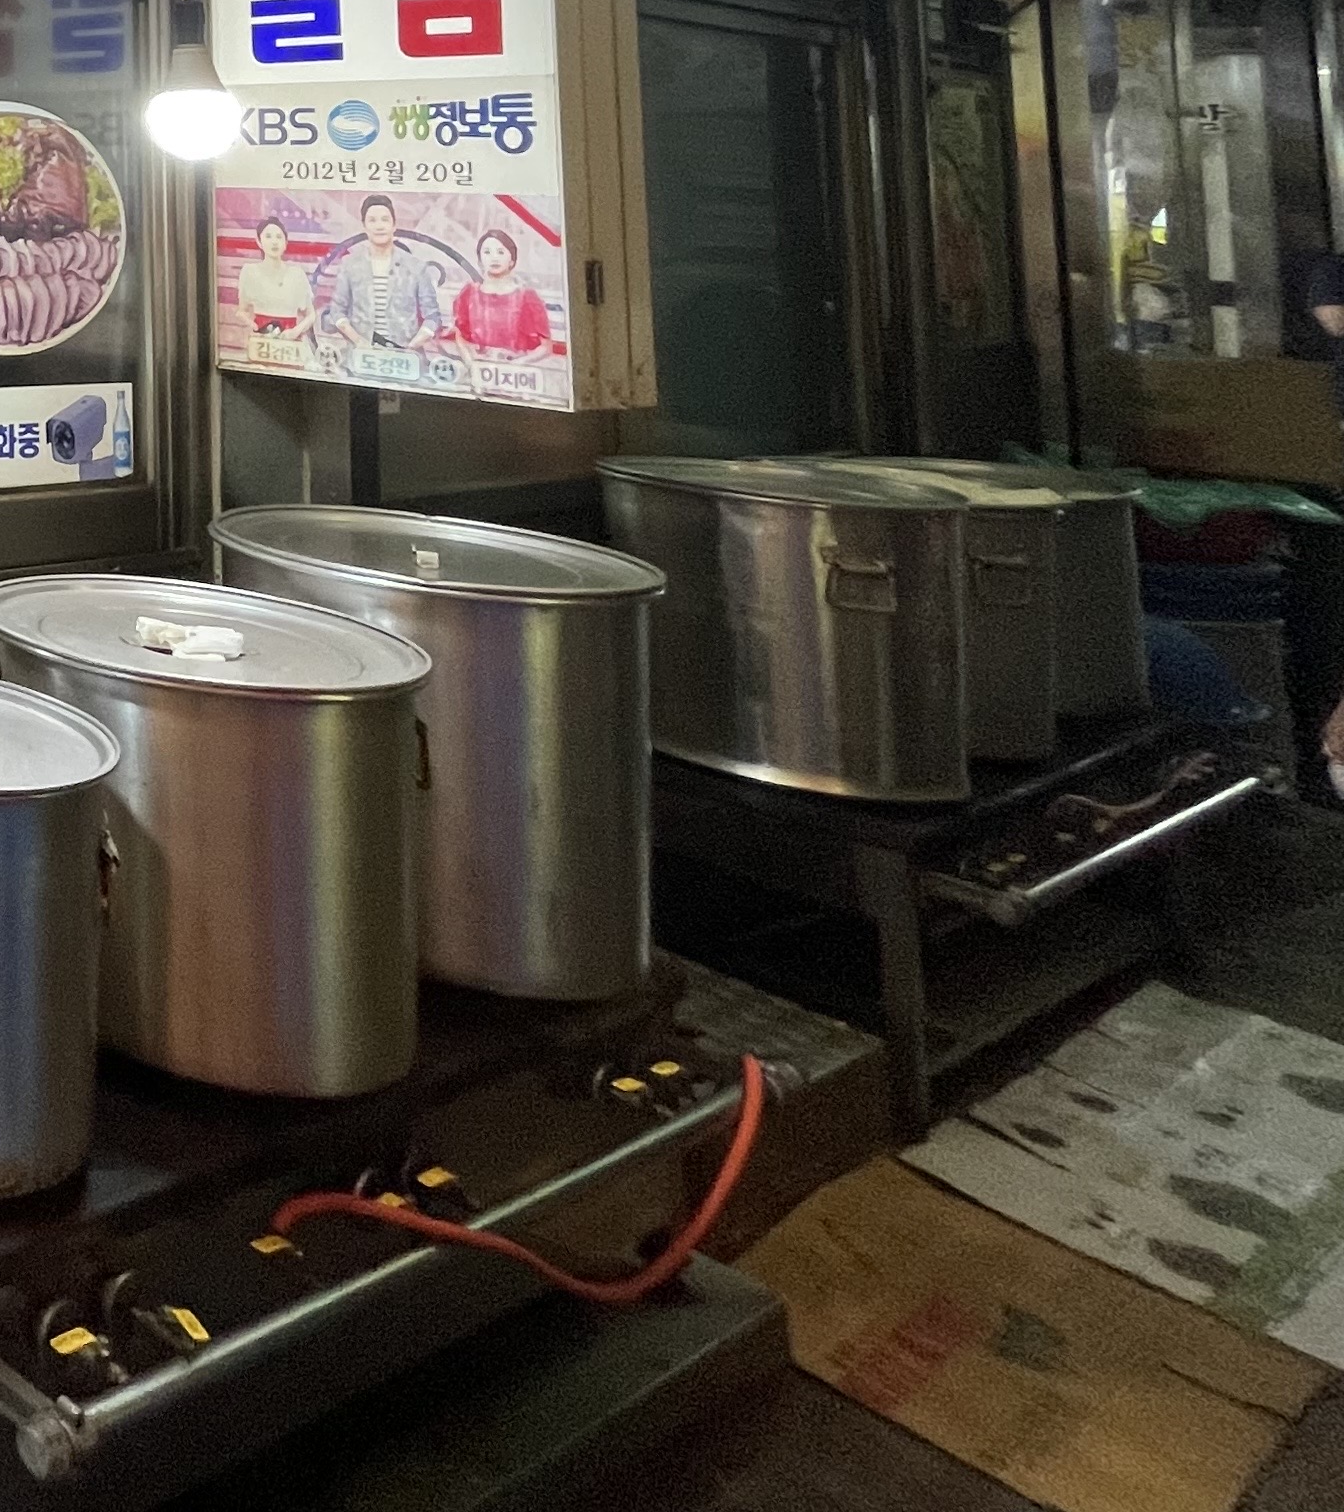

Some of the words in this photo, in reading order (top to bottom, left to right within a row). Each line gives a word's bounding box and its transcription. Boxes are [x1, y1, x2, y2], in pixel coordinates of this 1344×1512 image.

[389, 92, 537, 154] 생생정보통
[282, 159, 359, 184] 2012년
[368, 159, 406, 185] 2월
[416, 159, 475, 187] 20일
